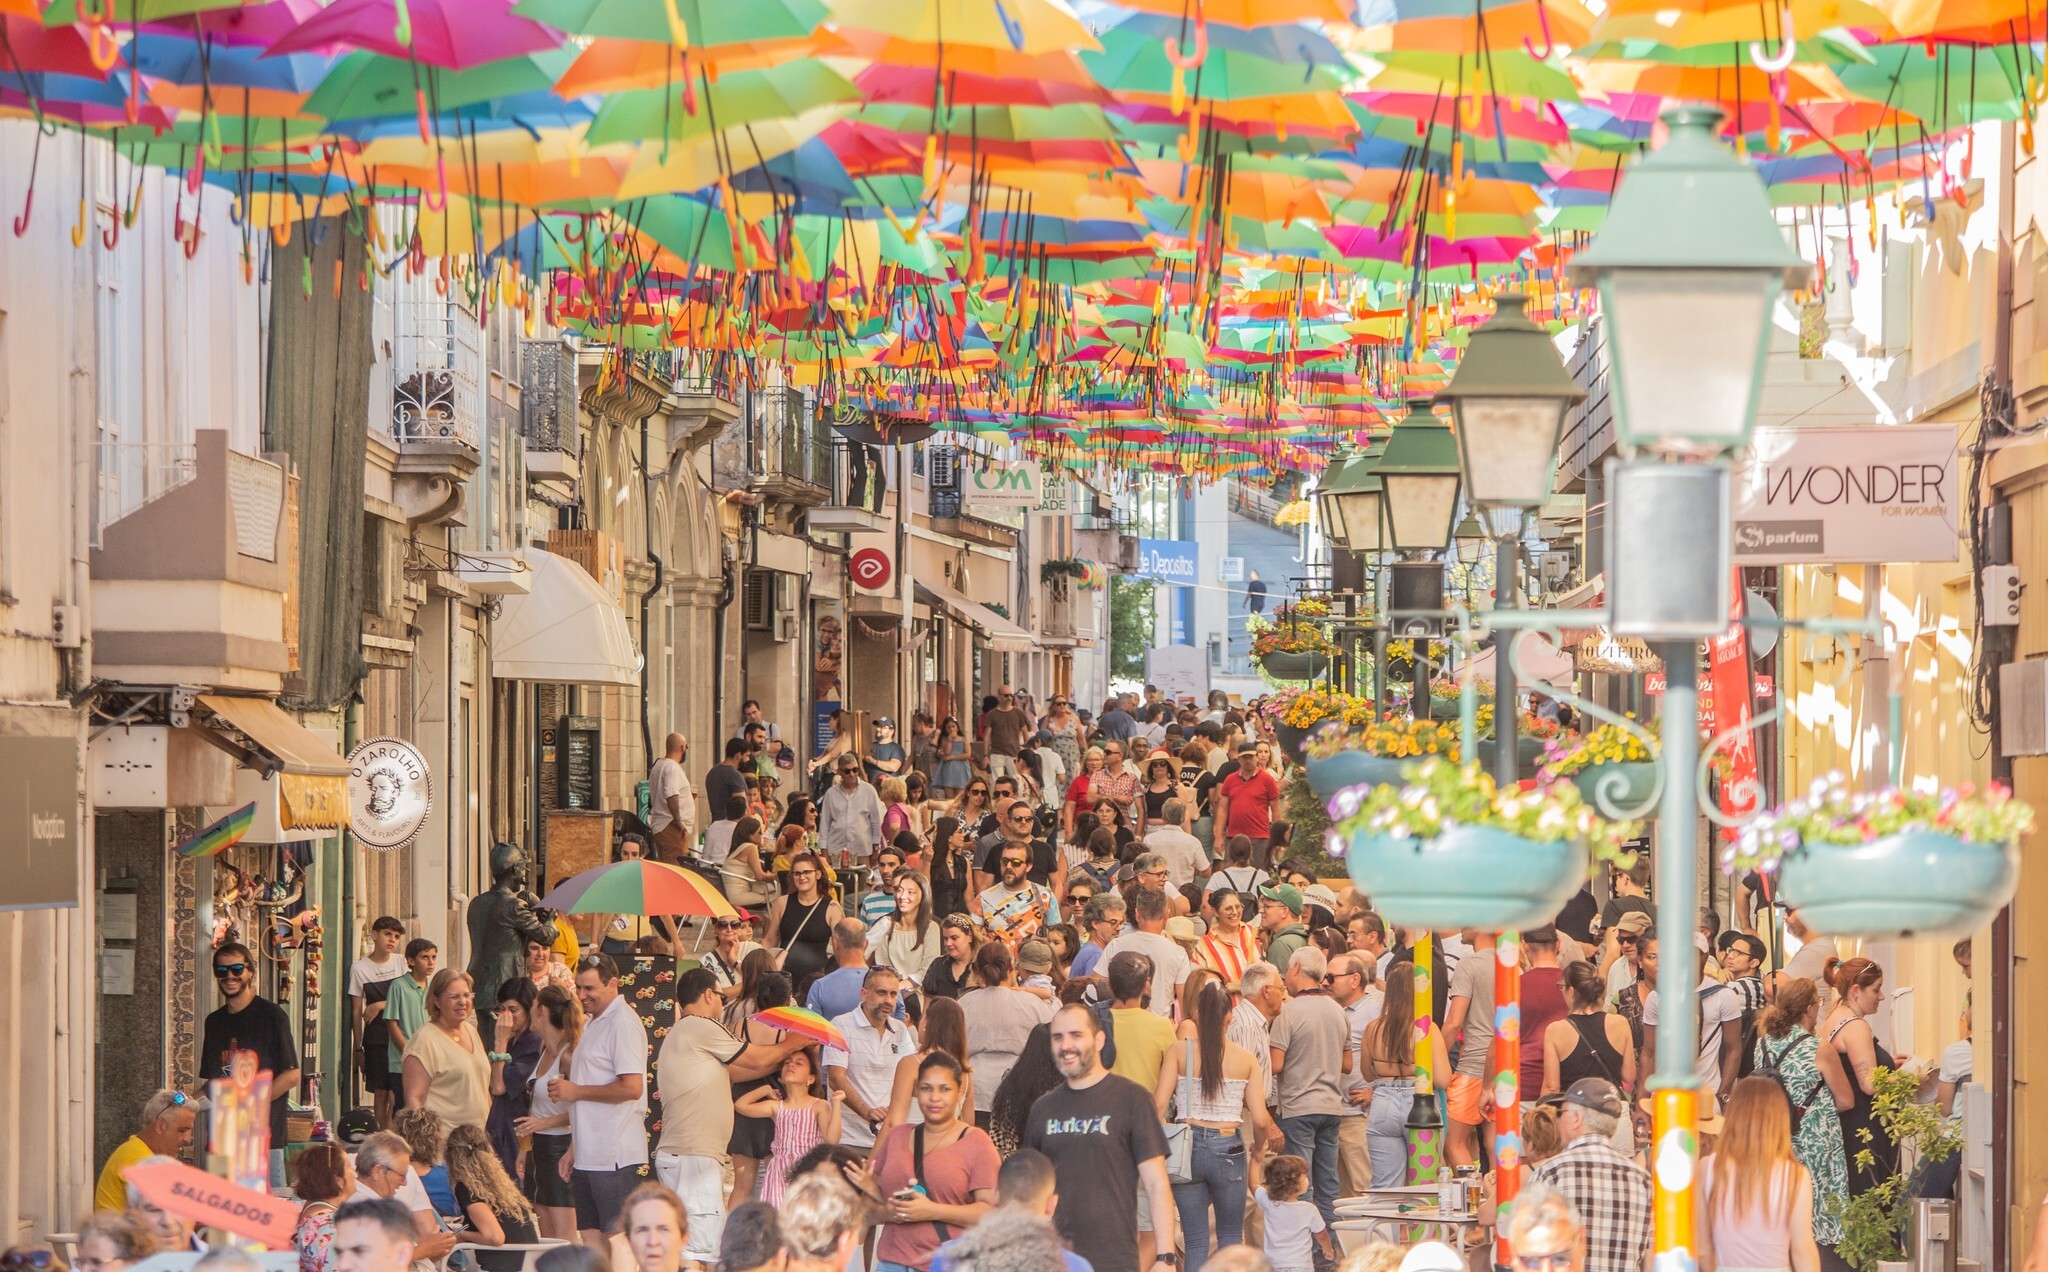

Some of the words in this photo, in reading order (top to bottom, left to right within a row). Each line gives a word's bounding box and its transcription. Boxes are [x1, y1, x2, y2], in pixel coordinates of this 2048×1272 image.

[1043, 477, 1065, 488] RAN
[1766, 465, 1945, 506] WONDER
[1043, 489, 1066, 500] UILI
[1881, 506, 1902, 517] FOR
[1904, 505, 1947, 517] WOMEN
[1766, 531, 1819, 547] parfum
[352, 767, 362, 778] O
[360, 747, 420, 780] ZAROLHO
[357, 818, 371, 833] ARTS
[378, 820, 411, 838] FLAVOURS
[171, 1182, 273, 1225] SALGADOS
